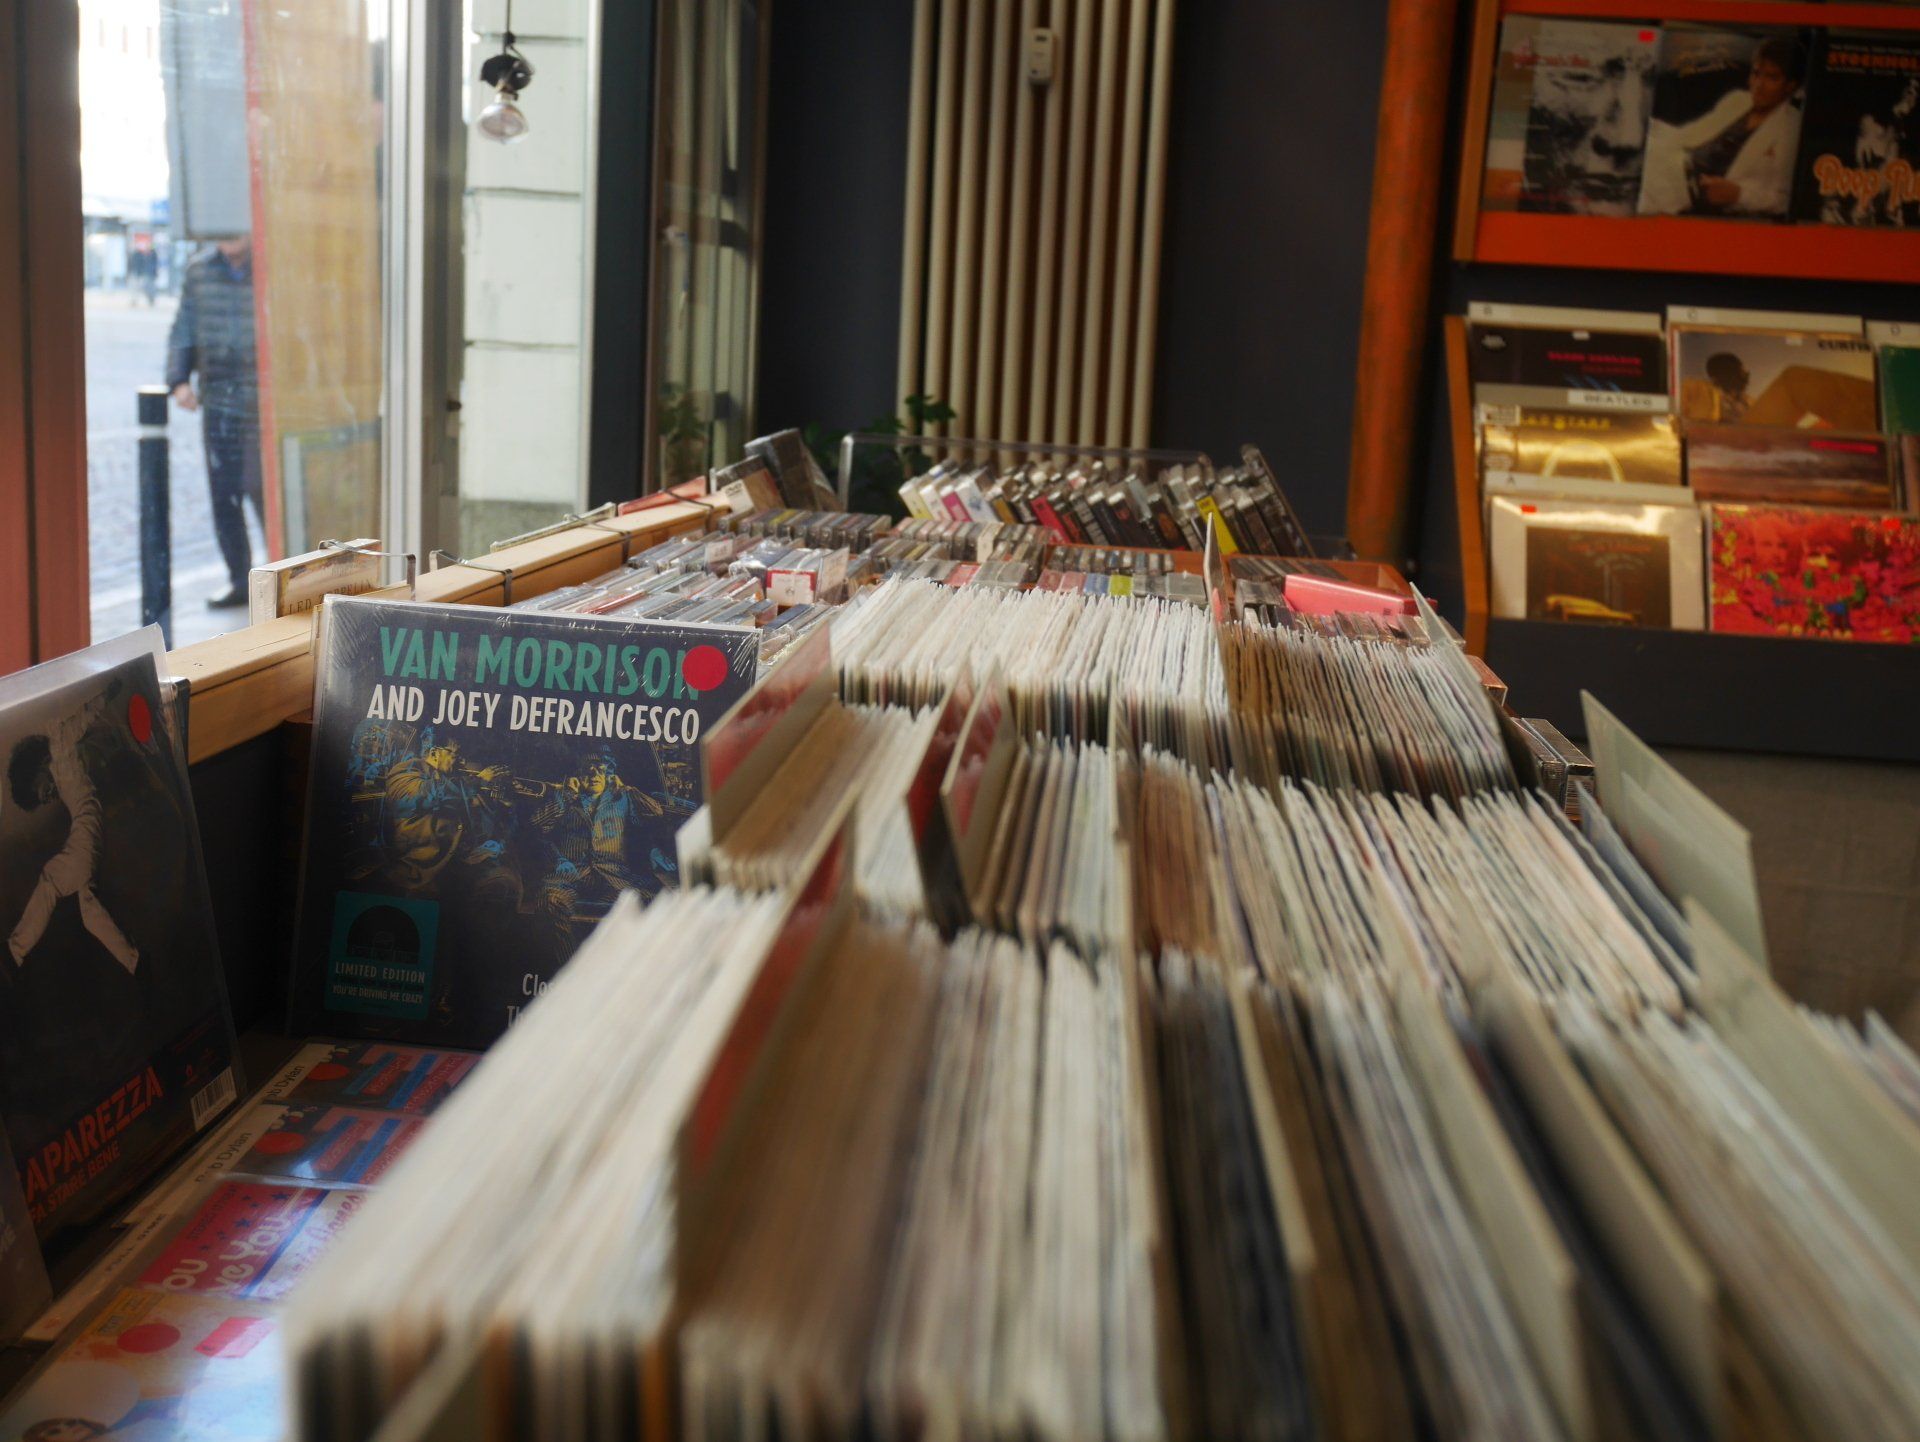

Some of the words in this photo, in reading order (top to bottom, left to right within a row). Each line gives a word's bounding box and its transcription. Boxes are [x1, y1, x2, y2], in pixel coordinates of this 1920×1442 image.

[379, 625, 460, 682] VAN
[366, 683, 425, 723] AND
[432, 688, 502, 729] JOEY
[509, 694, 701, 746] DEFRANCESCO
[335, 960, 377, 978] LIMITED
[382, 967, 426, 984] EDITION
[215, 1132, 253, 1160] Dylan
